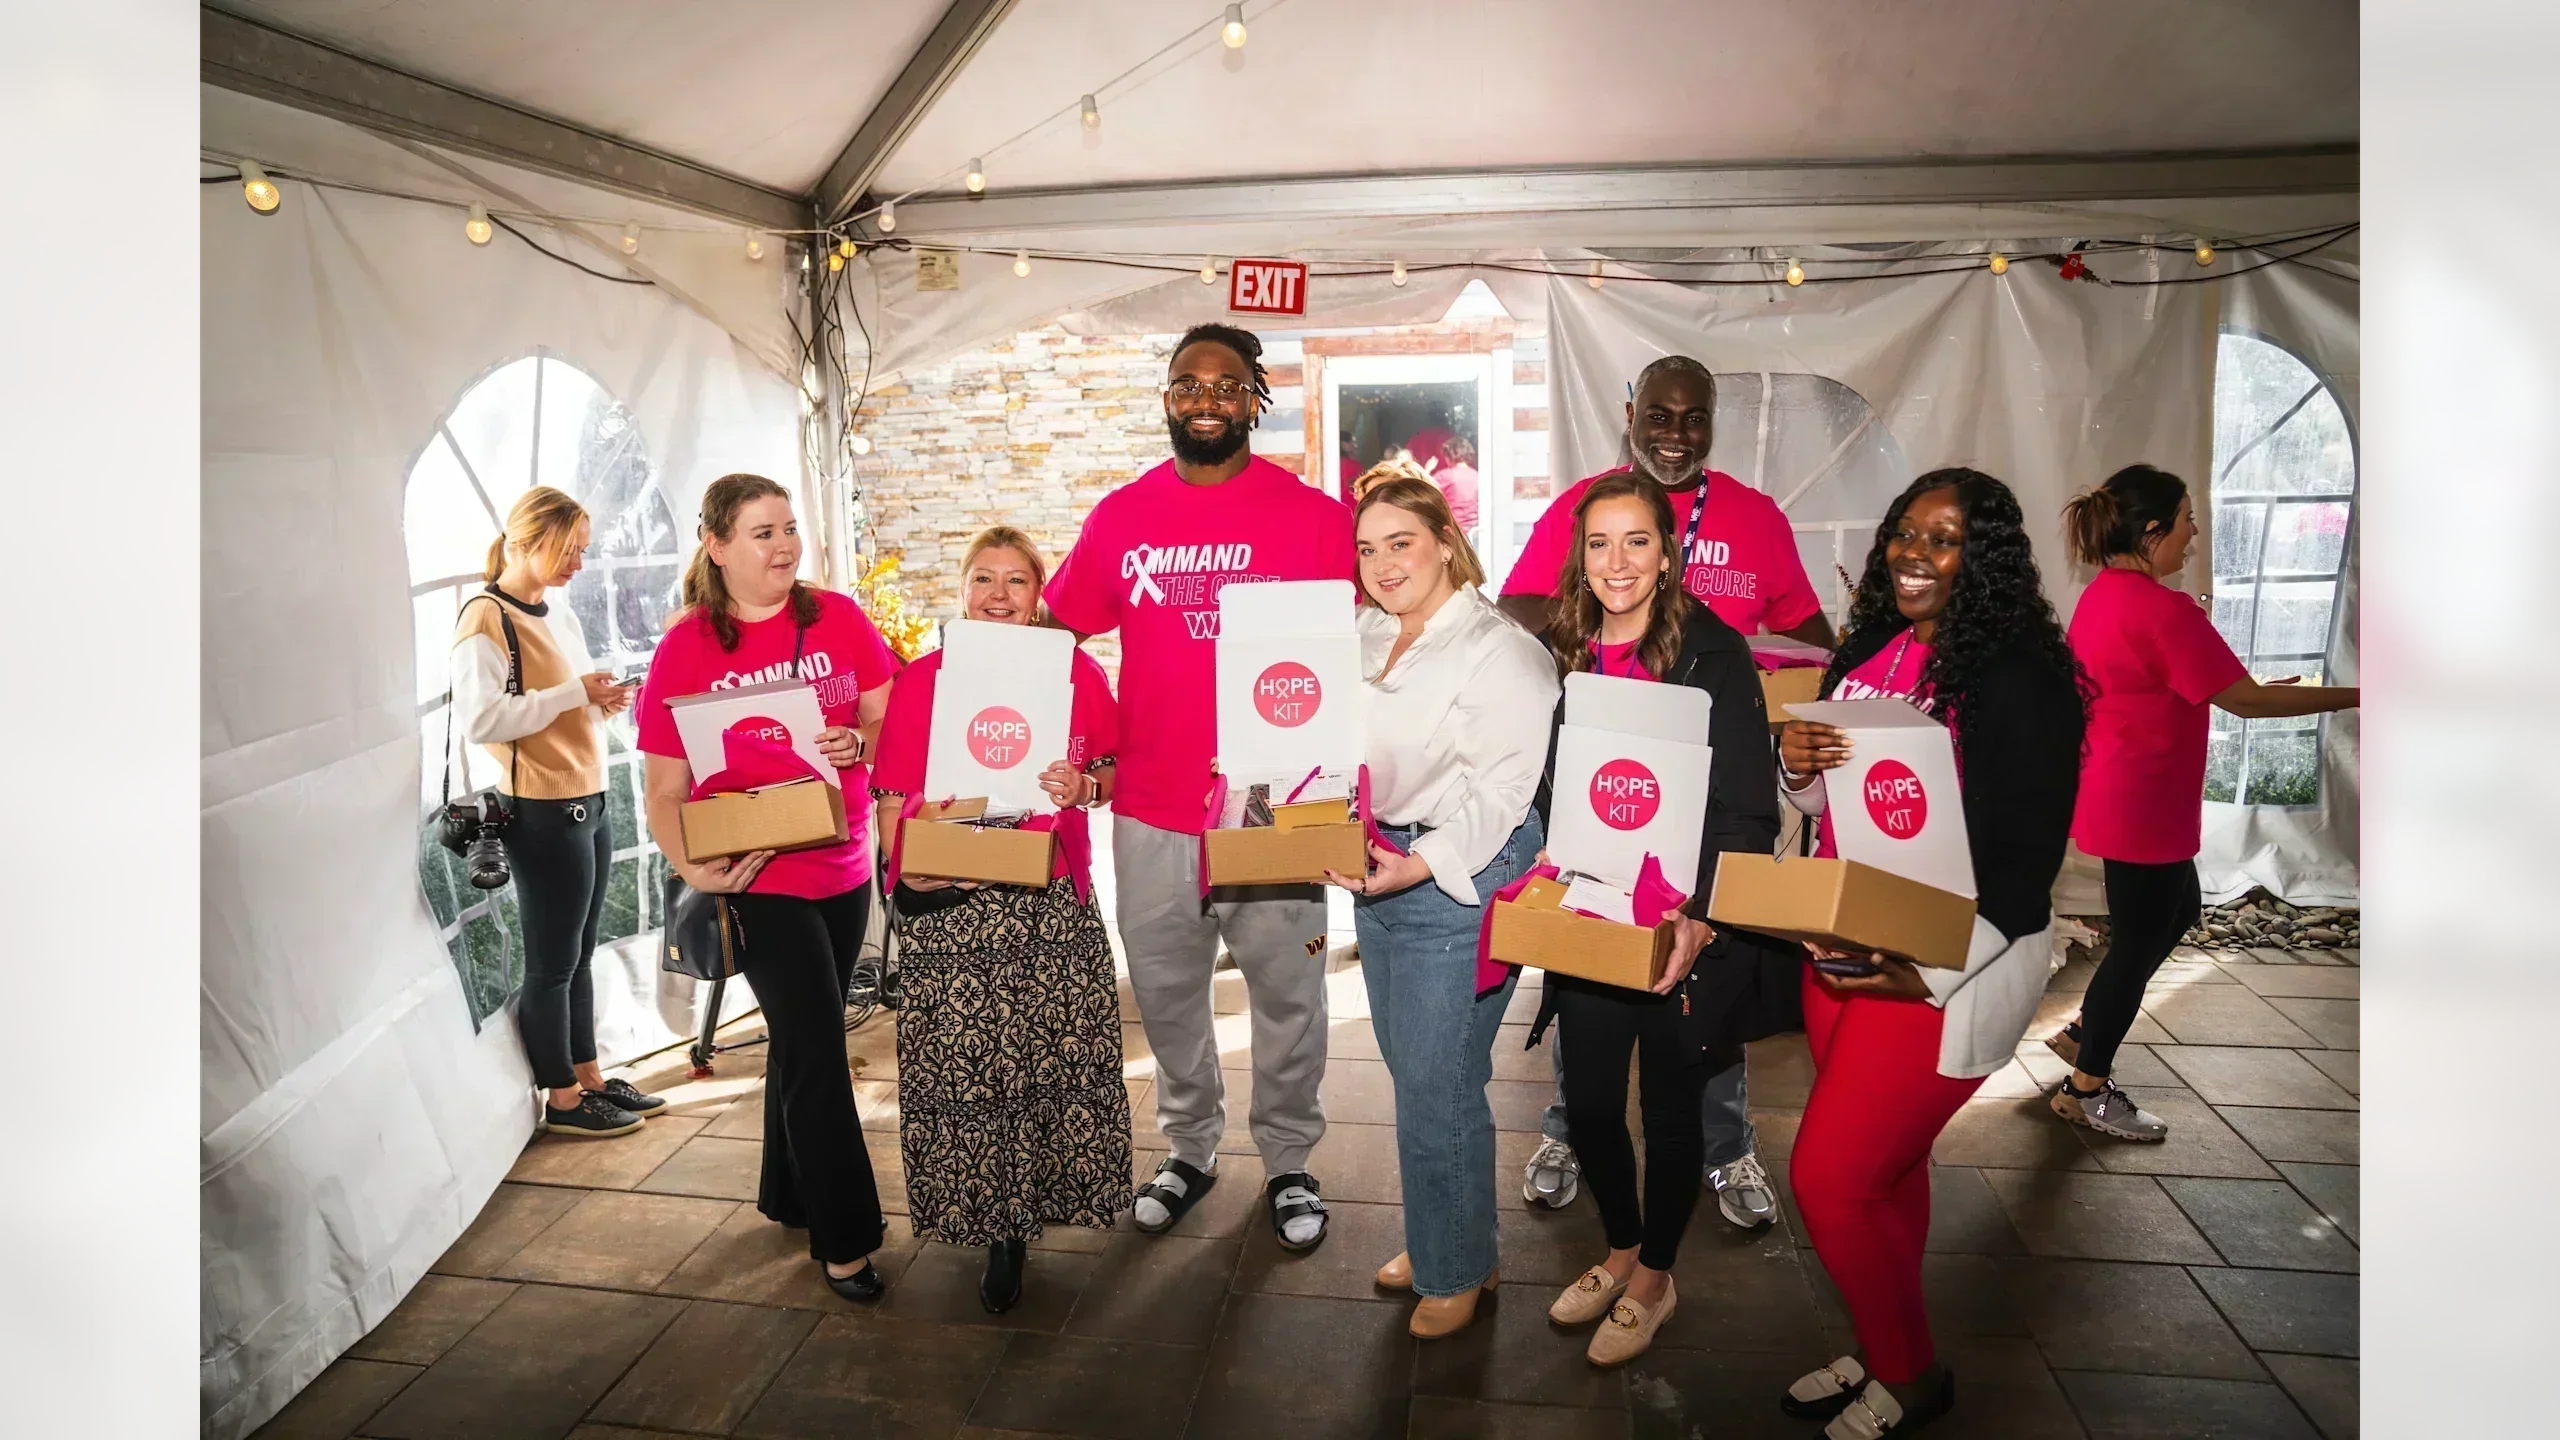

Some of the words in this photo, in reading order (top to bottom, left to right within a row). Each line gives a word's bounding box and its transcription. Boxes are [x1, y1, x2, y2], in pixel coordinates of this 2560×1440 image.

[1235, 265, 1301, 309] EXIT
[1121, 543, 1252, 585] COMMAND
[1156, 575, 1206, 606] THE
[1691, 566, 1757, 600] CURE
[1260, 677, 1316, 699] HOPE
[1273, 702, 1303, 721] KIT
[742, 725, 787, 742] PE
[973, 720, 1028, 742] HOPE
[984, 745, 1014, 763] KIT
[1597, 773, 1657, 800] HOPE
[1866, 777, 1921, 805] HOPE
[1608, 802, 1640, 824] KIT
[1884, 808, 1912, 831] KIT
